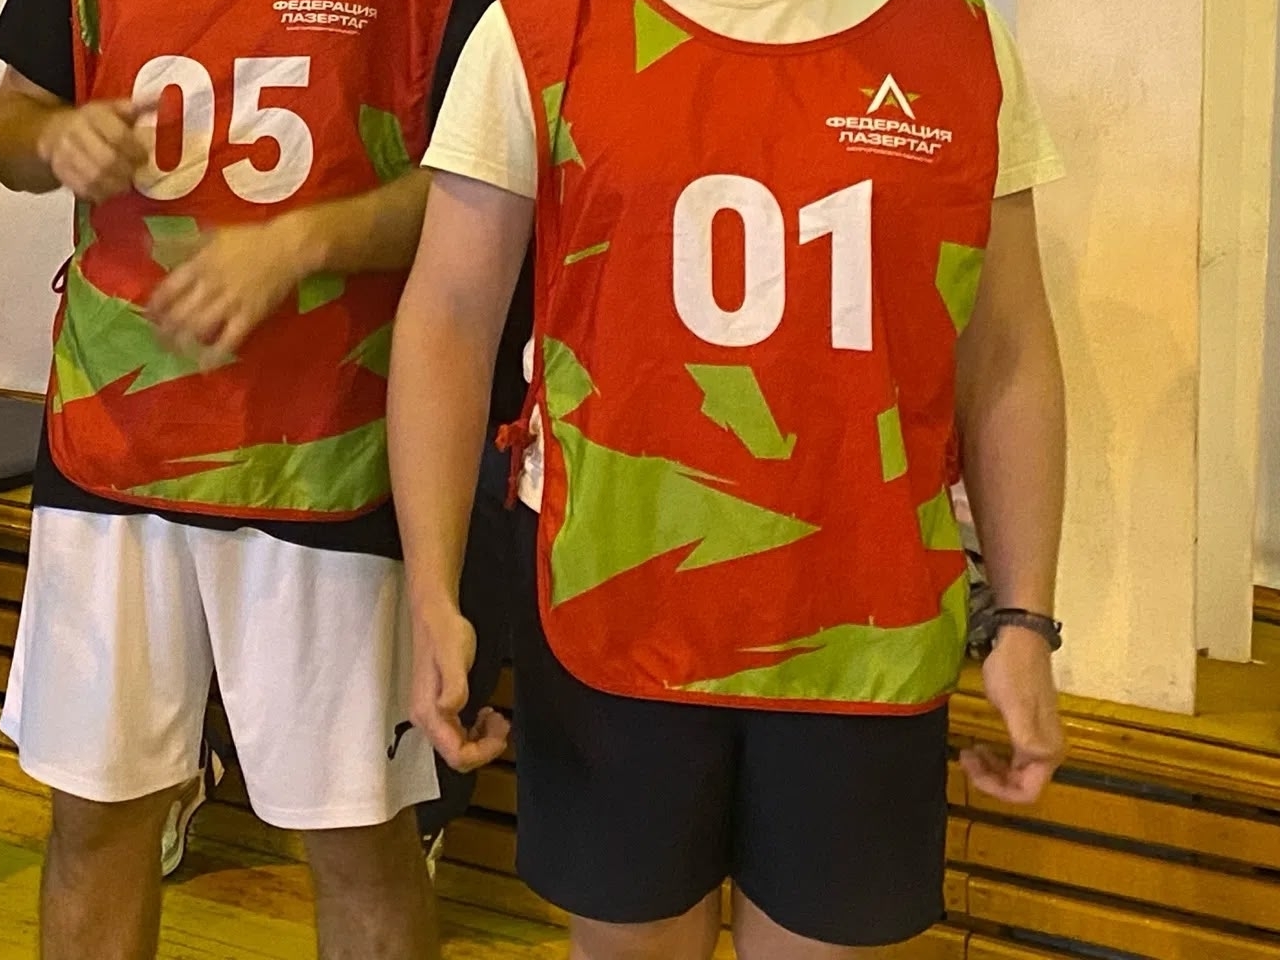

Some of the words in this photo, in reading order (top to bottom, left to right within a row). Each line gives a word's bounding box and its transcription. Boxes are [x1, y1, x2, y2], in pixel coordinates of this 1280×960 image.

[272, 0, 377, 18] ФЕДЕРАЦИЯ
[281, 13, 368, 29] ЛАЗЕРТАГ
[132, 55, 314, 204] 05
[825, 116, 952, 143] ФЕДЕРАЦИЯ
[839, 131, 942, 154] ЛАЗЕРТАГ
[673, 174, 873, 351] 01
